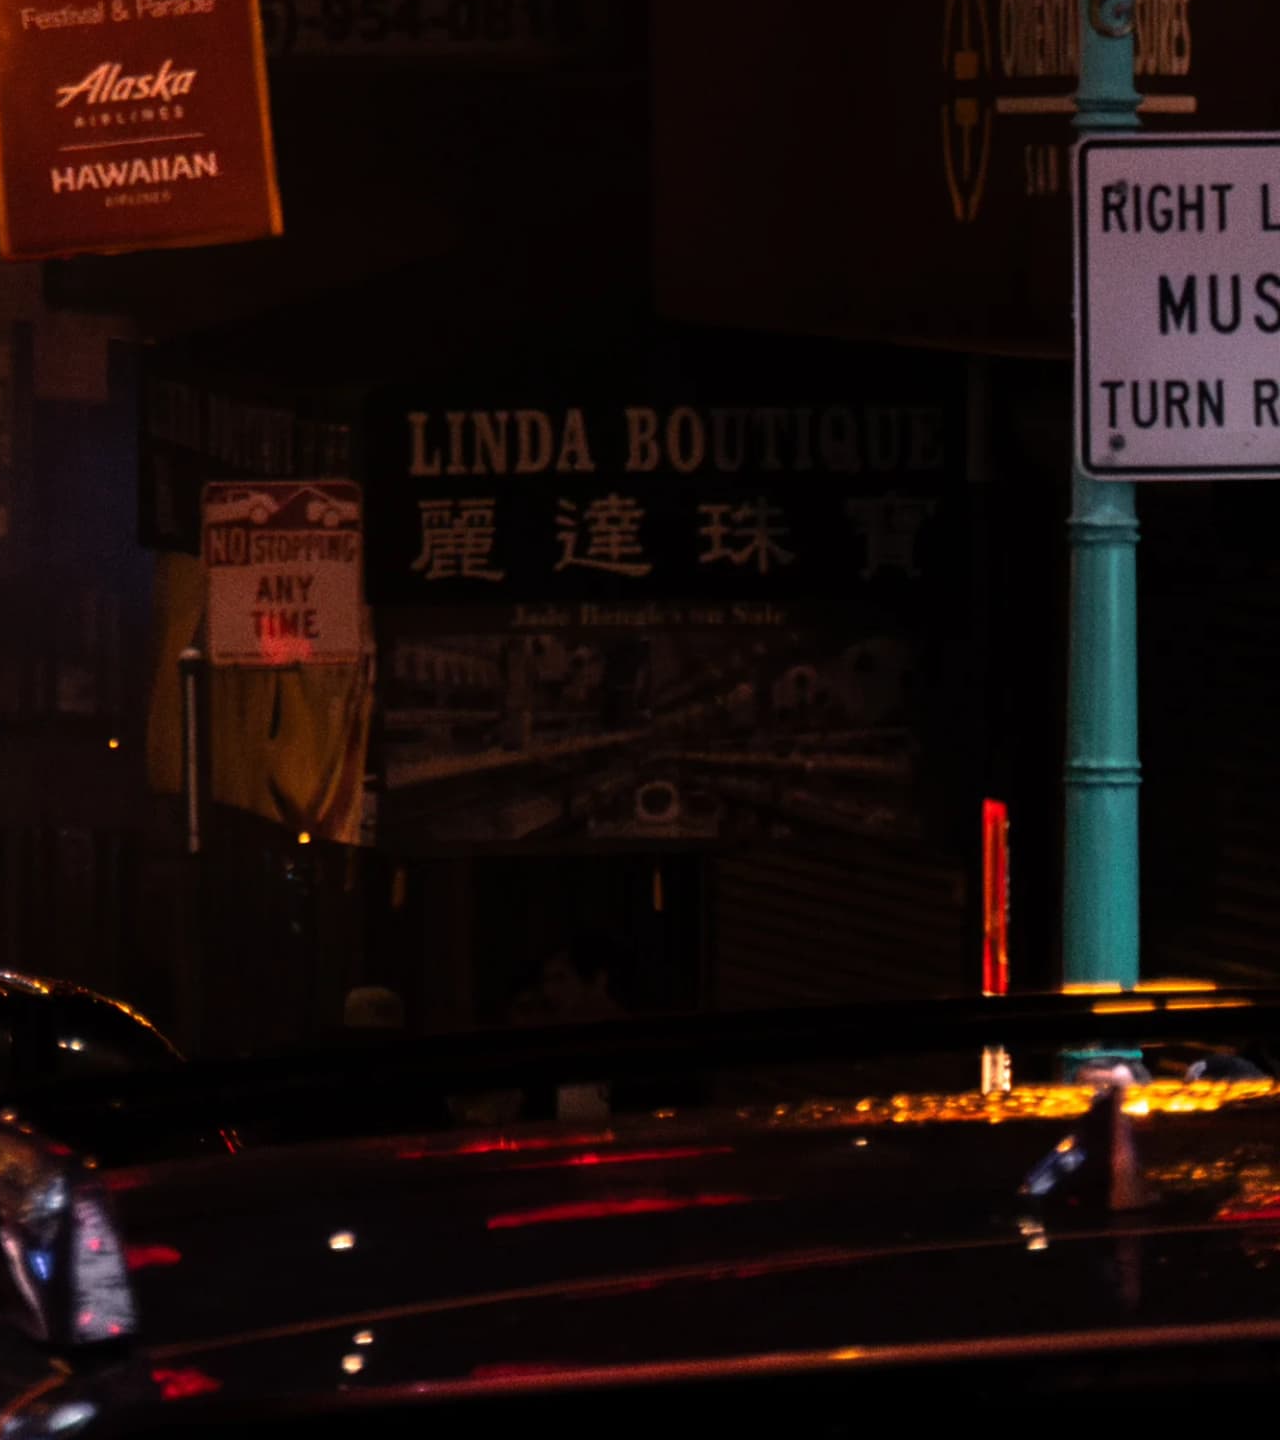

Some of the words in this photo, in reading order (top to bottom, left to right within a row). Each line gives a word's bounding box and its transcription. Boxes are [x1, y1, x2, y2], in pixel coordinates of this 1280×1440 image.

[55, 57, 199, 108] Alaska
[49, 150, 220, 196] HAWAIIAN
[1101, 181, 1234, 232] RIGHT
[1100, 380, 1225, 430] TURN
[405, 402, 600, 478] LINDA
[621, 401, 945, 476] BOUTIQUE
[255, 533, 354, 563] STOPPING
[257, 575, 314, 604] ANY
[251, 609, 319, 641] TIME
